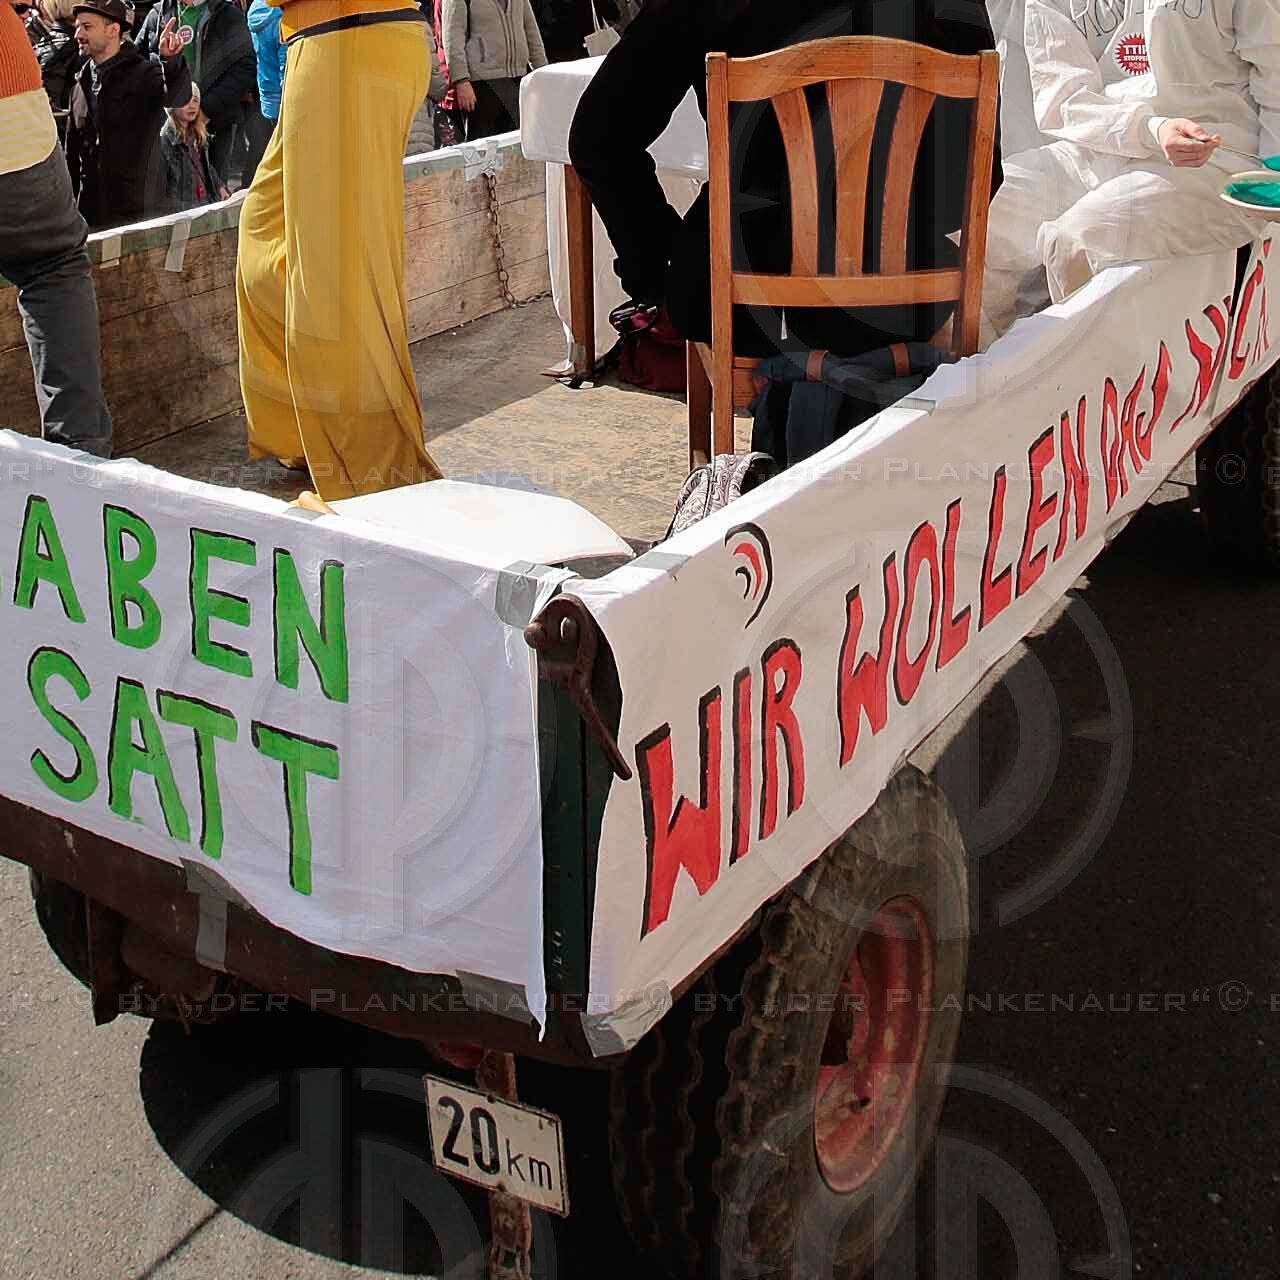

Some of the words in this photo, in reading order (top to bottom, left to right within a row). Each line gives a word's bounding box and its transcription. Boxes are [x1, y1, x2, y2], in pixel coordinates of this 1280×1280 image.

[1123, 44, 1147, 56] TTI
[635, 637, 804, 941] WIR
[837, 396, 1090, 768] WOLLEN
[27, 646, 341, 897] SATT
[438, 1095, 501, 1175] 20
[505, 1138, 553, 1192] km
